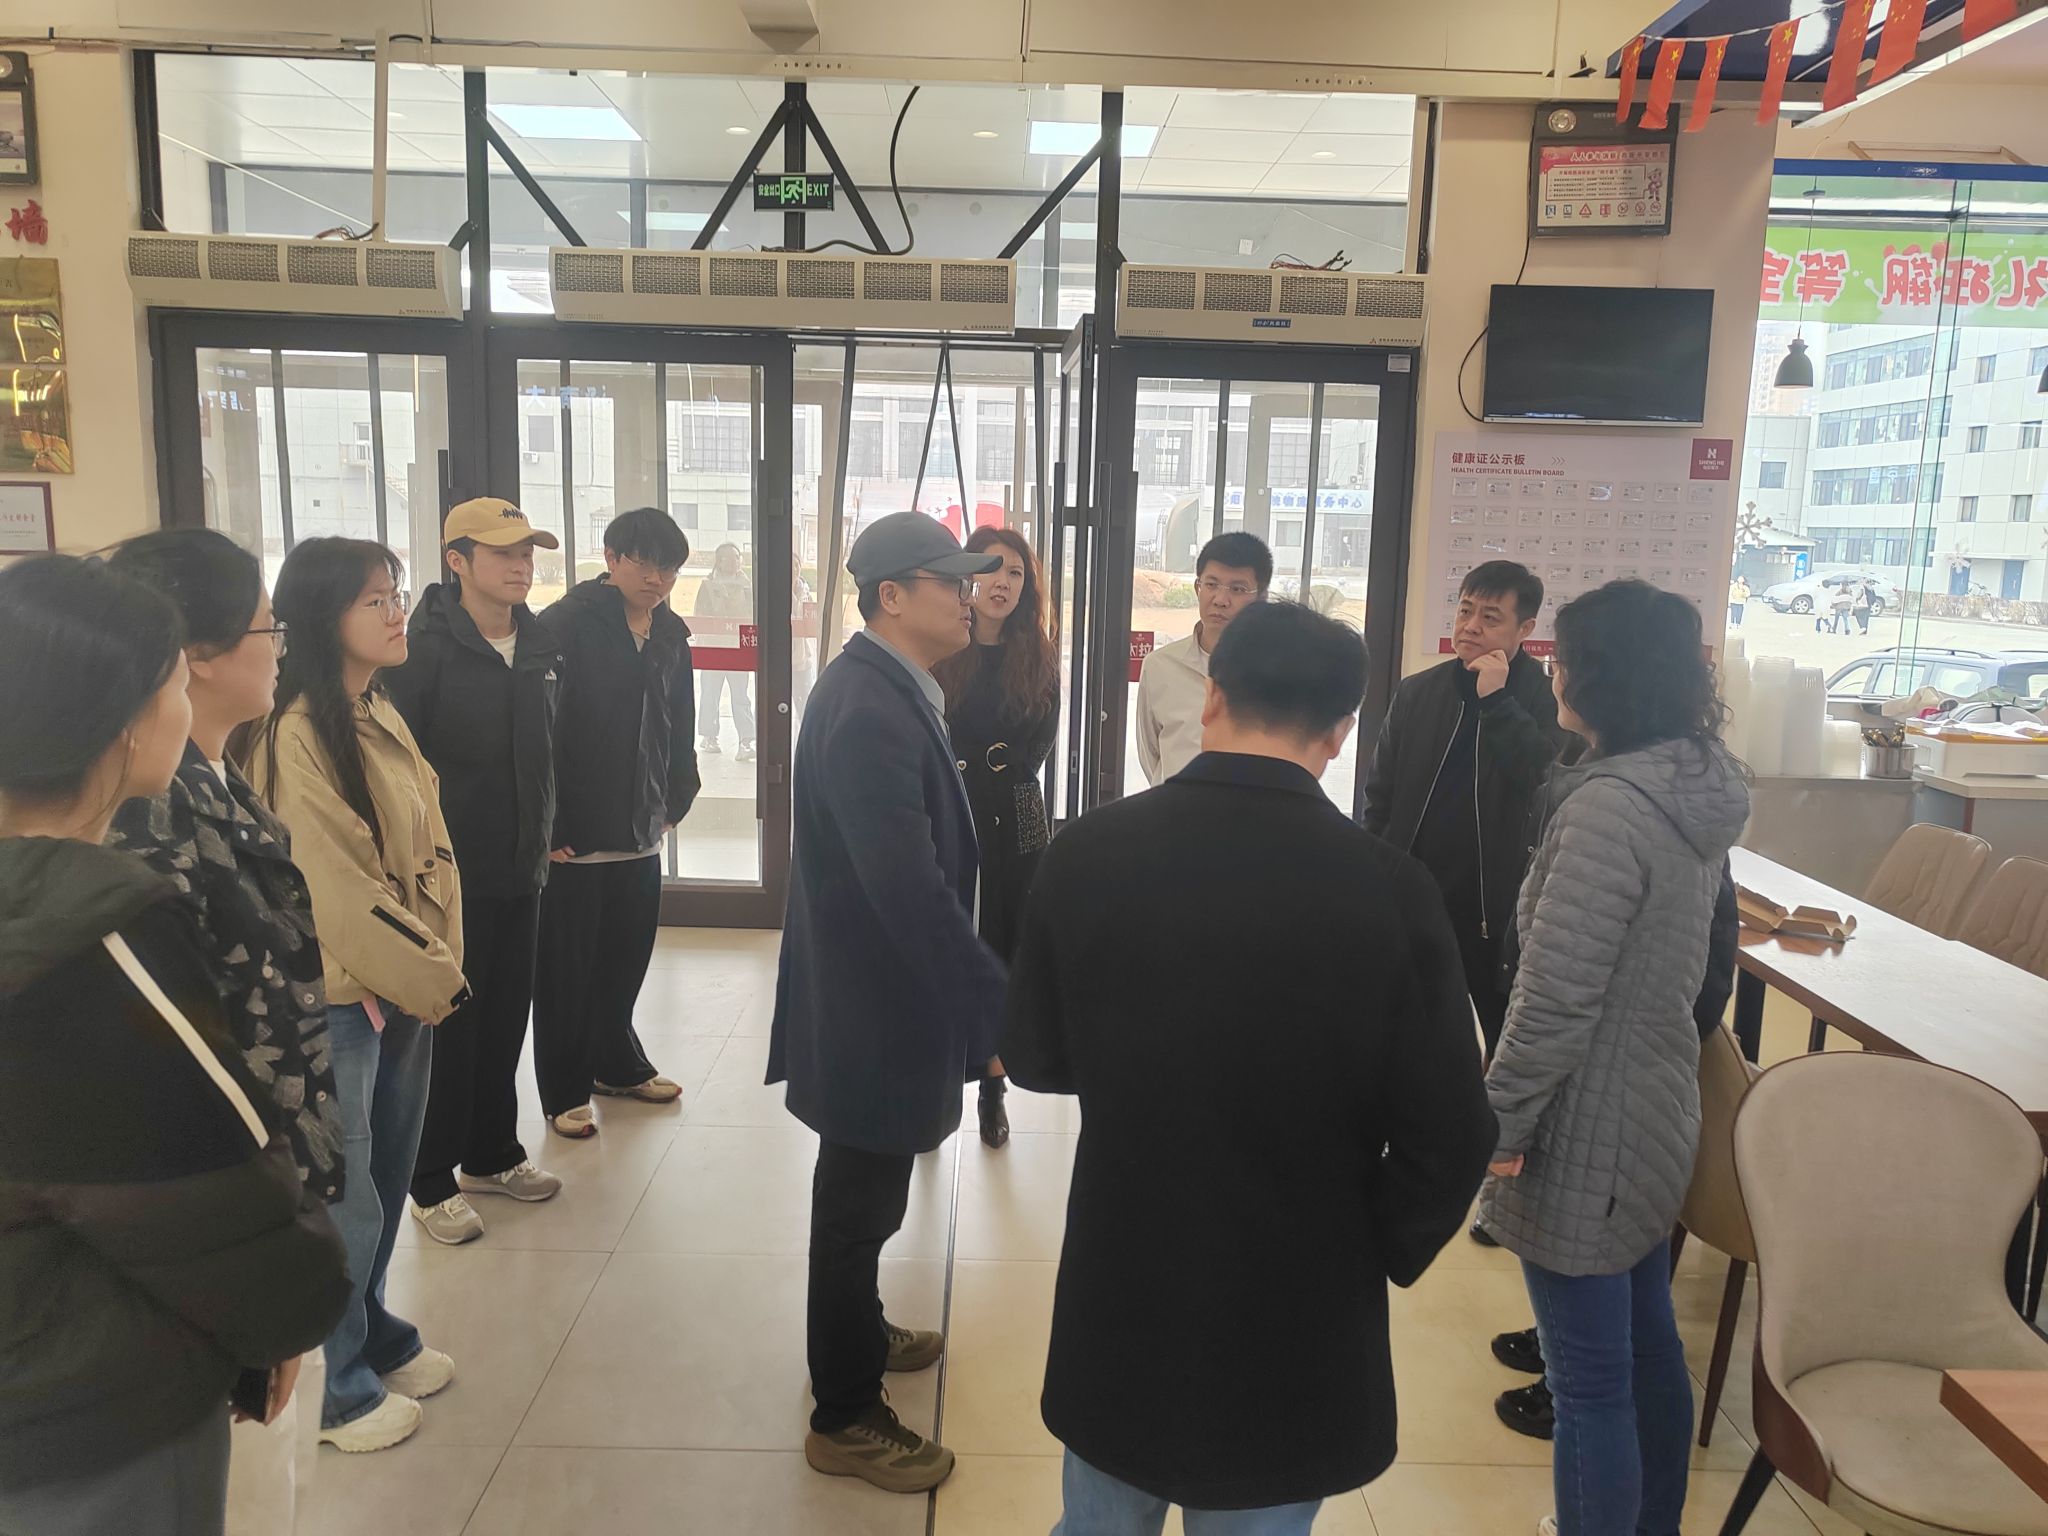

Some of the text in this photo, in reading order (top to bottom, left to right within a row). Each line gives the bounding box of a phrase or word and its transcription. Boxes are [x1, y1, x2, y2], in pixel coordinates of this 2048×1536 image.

[807, 183, 829, 197] EXIT
[1452, 452, 1526, 466] 健康证公示板
[1475, 467, 1513, 475] CERTIFICATE
[1513, 468, 1542, 476] BULLETIN
